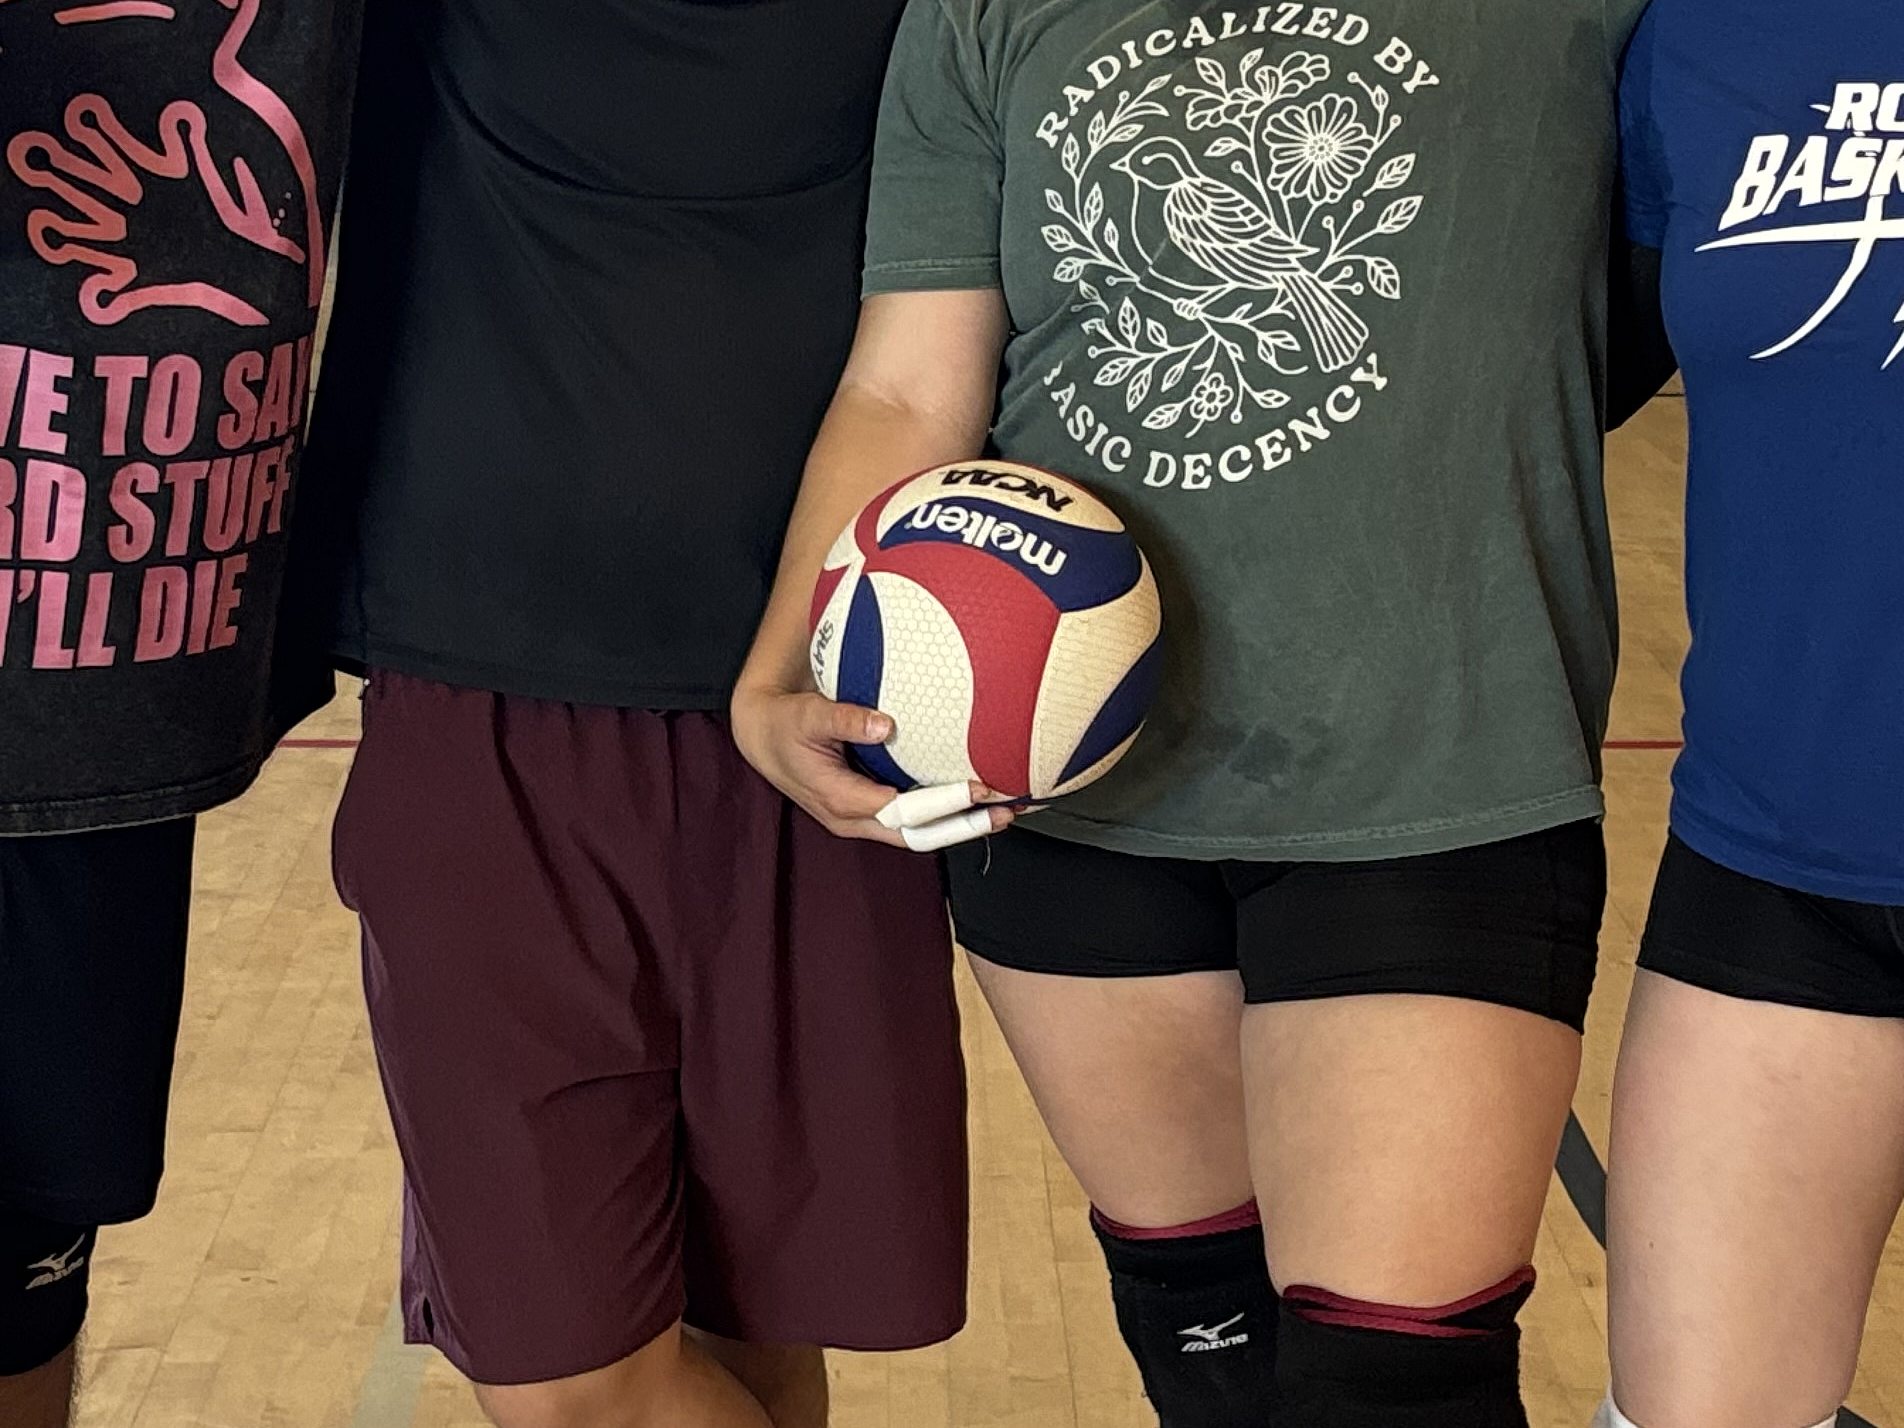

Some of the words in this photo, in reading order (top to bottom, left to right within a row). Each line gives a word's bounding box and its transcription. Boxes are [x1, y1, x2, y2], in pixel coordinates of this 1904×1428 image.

[1035, 2, 1369, 149] RADICALIZED
[1373, 36, 1440, 94] BY
[94, 353, 202, 456] TO
[1143, 352, 1388, 490] DECENCY
[911, 502, 1068, 576] molten
[941, 468, 1075, 513] NCAA
[133, 552, 249, 663] DIE
